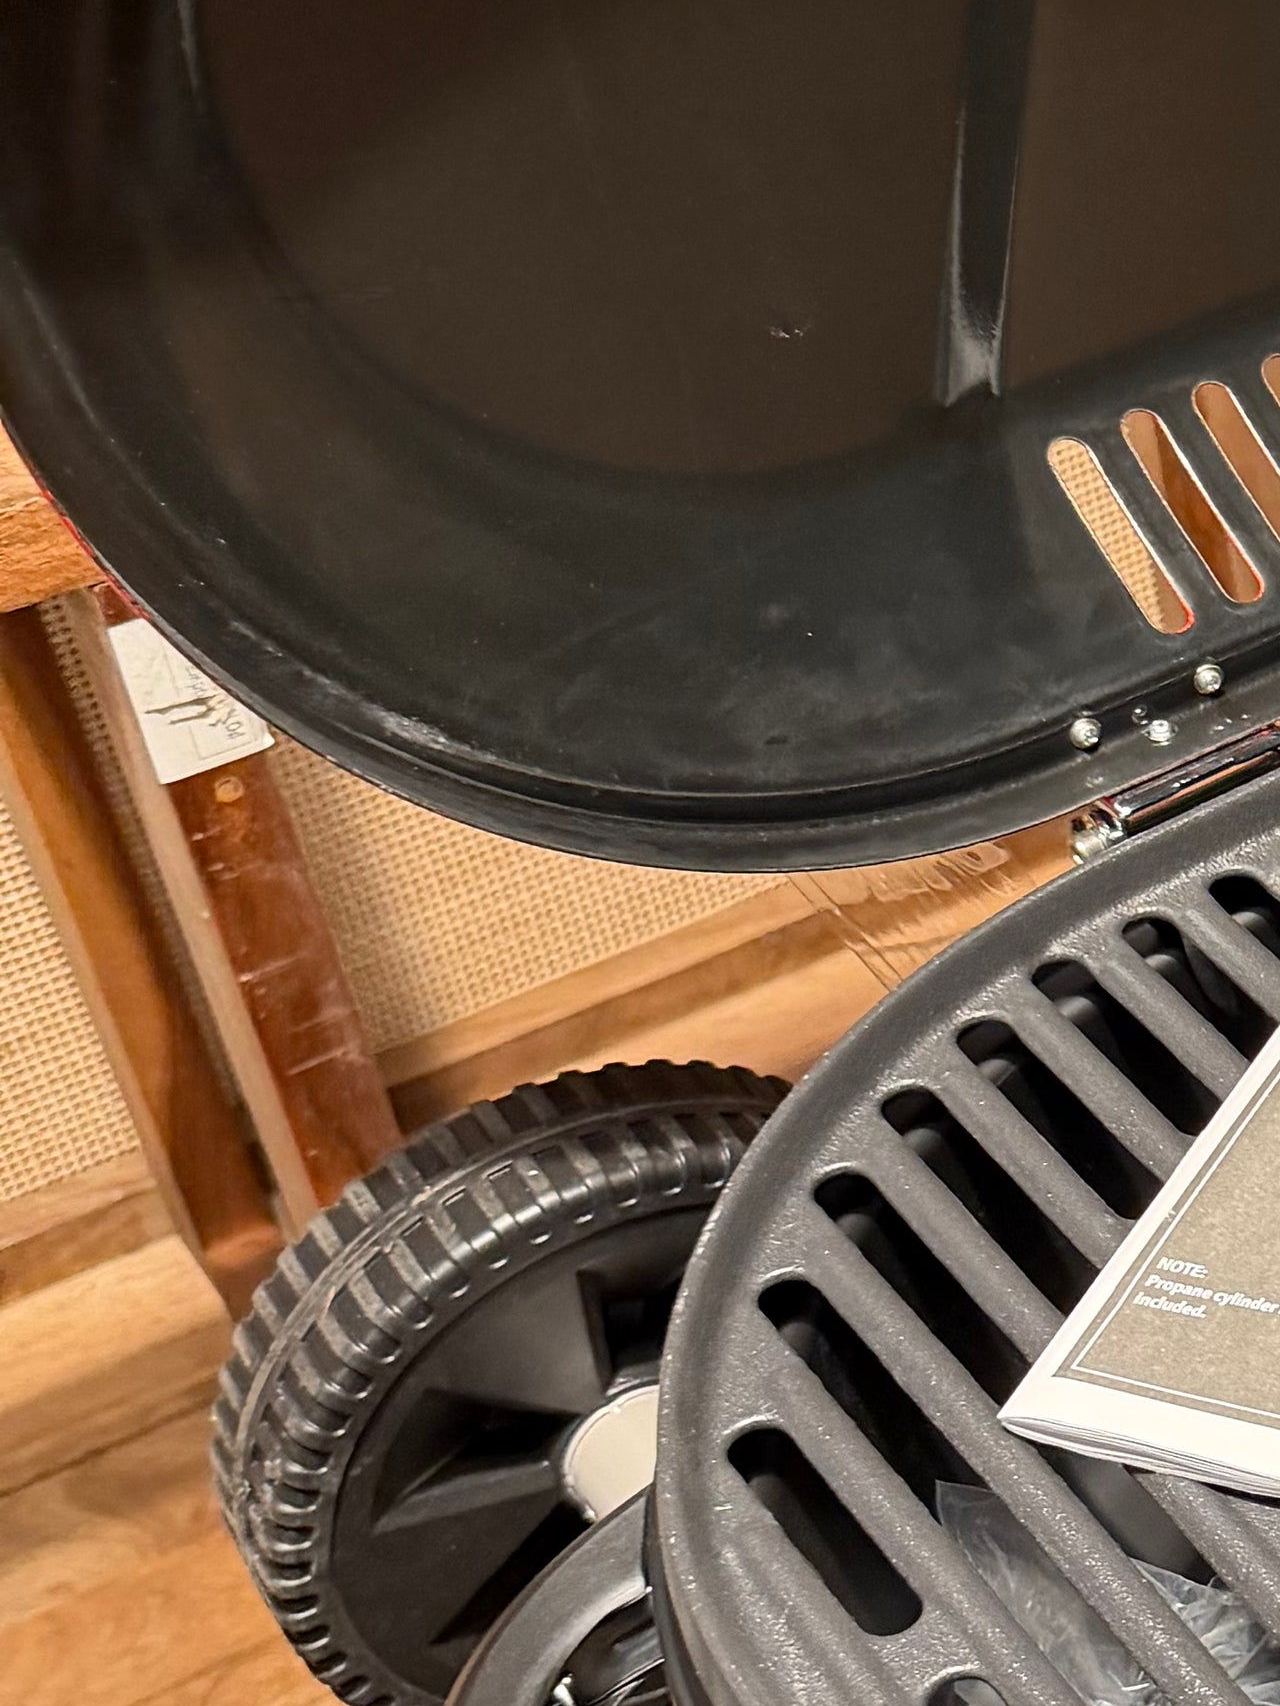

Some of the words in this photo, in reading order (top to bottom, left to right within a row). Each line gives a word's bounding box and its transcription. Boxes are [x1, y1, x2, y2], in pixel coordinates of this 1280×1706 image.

[1156, 1257, 1209, 1280] NOTE:
[1132, 1291, 1208, 1319] included.
[1144, 1274, 1213, 1301] Propane
[1212, 1291, 1280, 1315] cylinder
